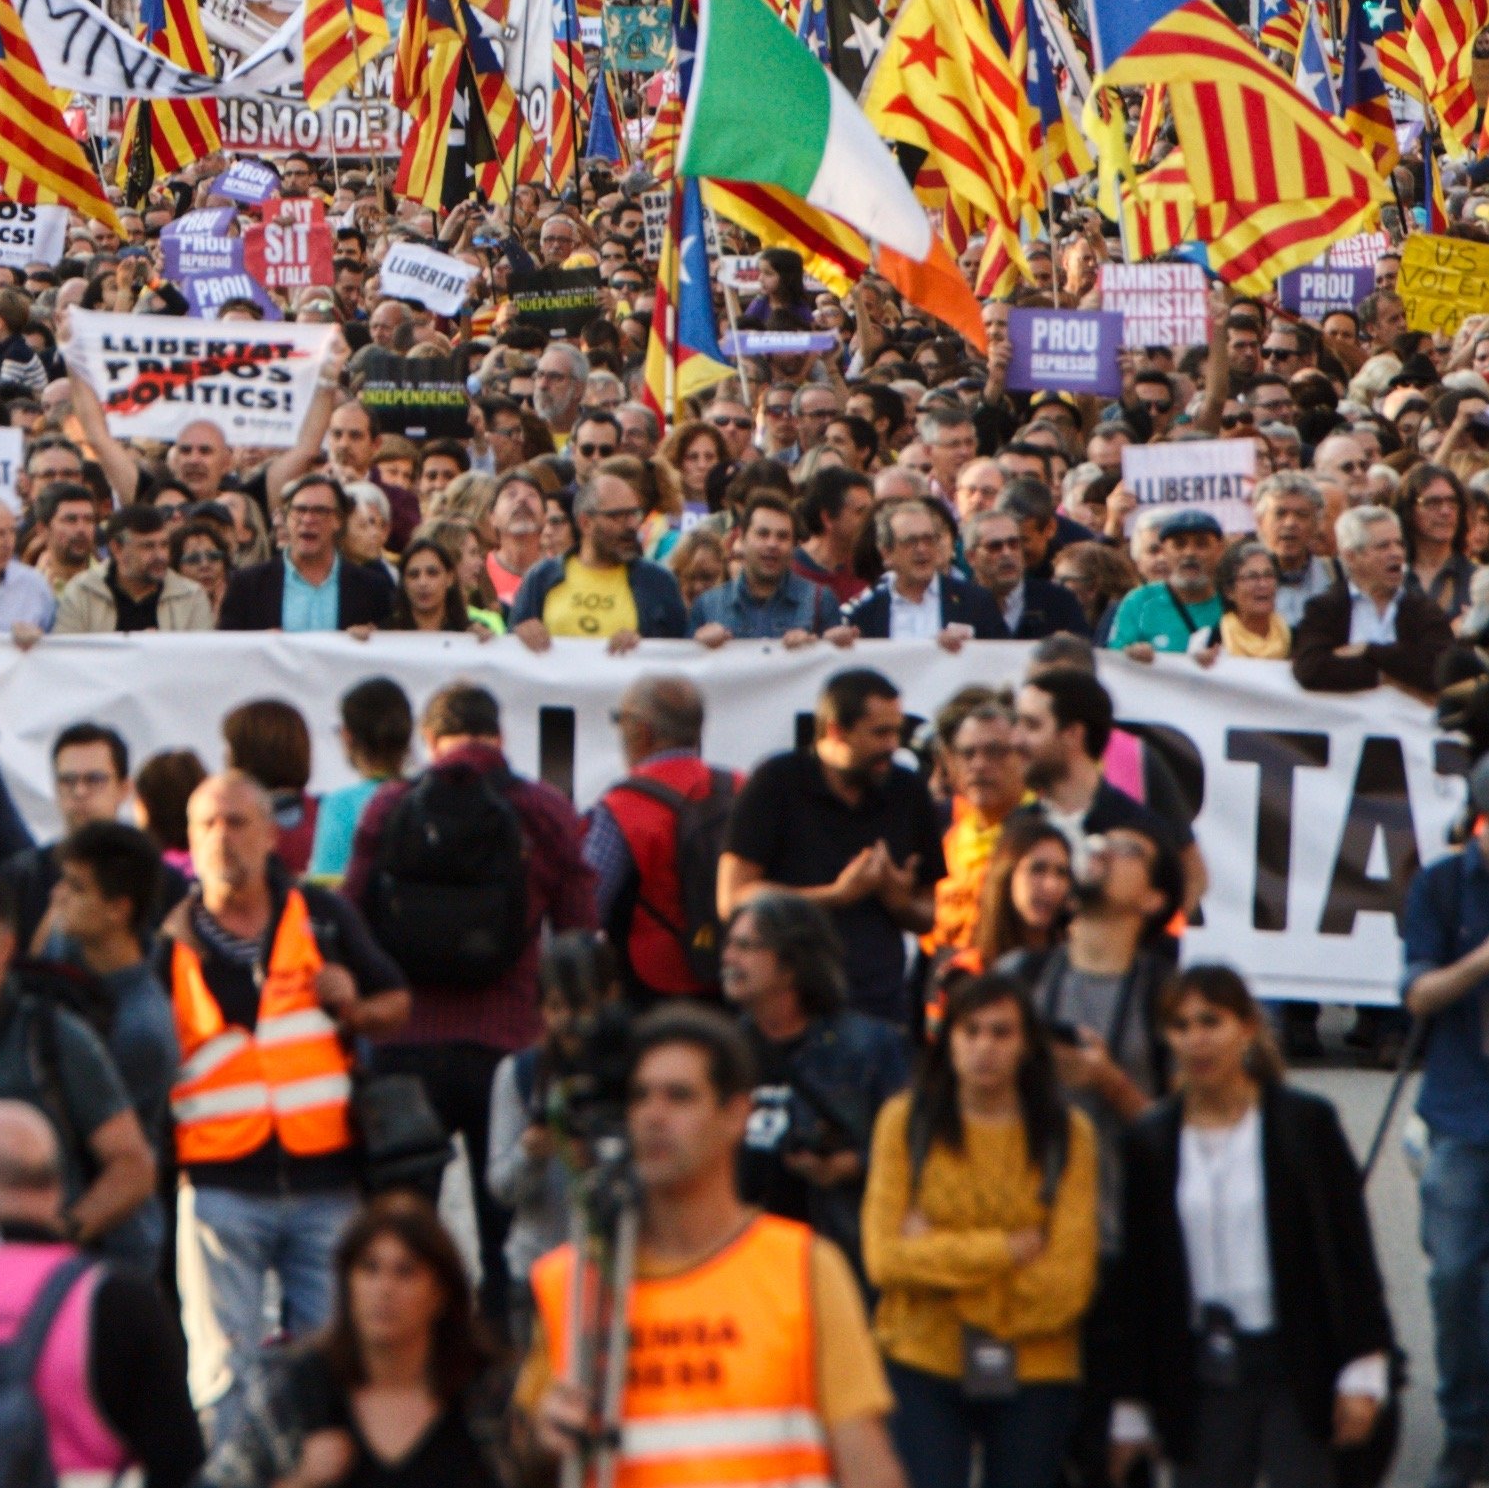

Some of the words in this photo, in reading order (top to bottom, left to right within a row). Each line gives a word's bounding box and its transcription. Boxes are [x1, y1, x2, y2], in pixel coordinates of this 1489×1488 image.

[264, 224, 310, 264] SIT
[1435, 241, 1477, 272] US
[277, 265, 311, 284] TALK
[387, 256, 465, 295] LLIBERTAT
[1102, 263, 1204, 290] AMNISTIA
[1300, 273, 1354, 299] PROU
[193, 273, 253, 306] PROU
[1102, 290, 1206, 318] AMNISTIA
[103, 335, 295, 361] LLIBERTAT
[1031, 317, 1099, 351] PROU
[1031, 353, 1098, 371] REPRESSIÓ
[1134, 473, 1244, 504] LLIBERTAT
